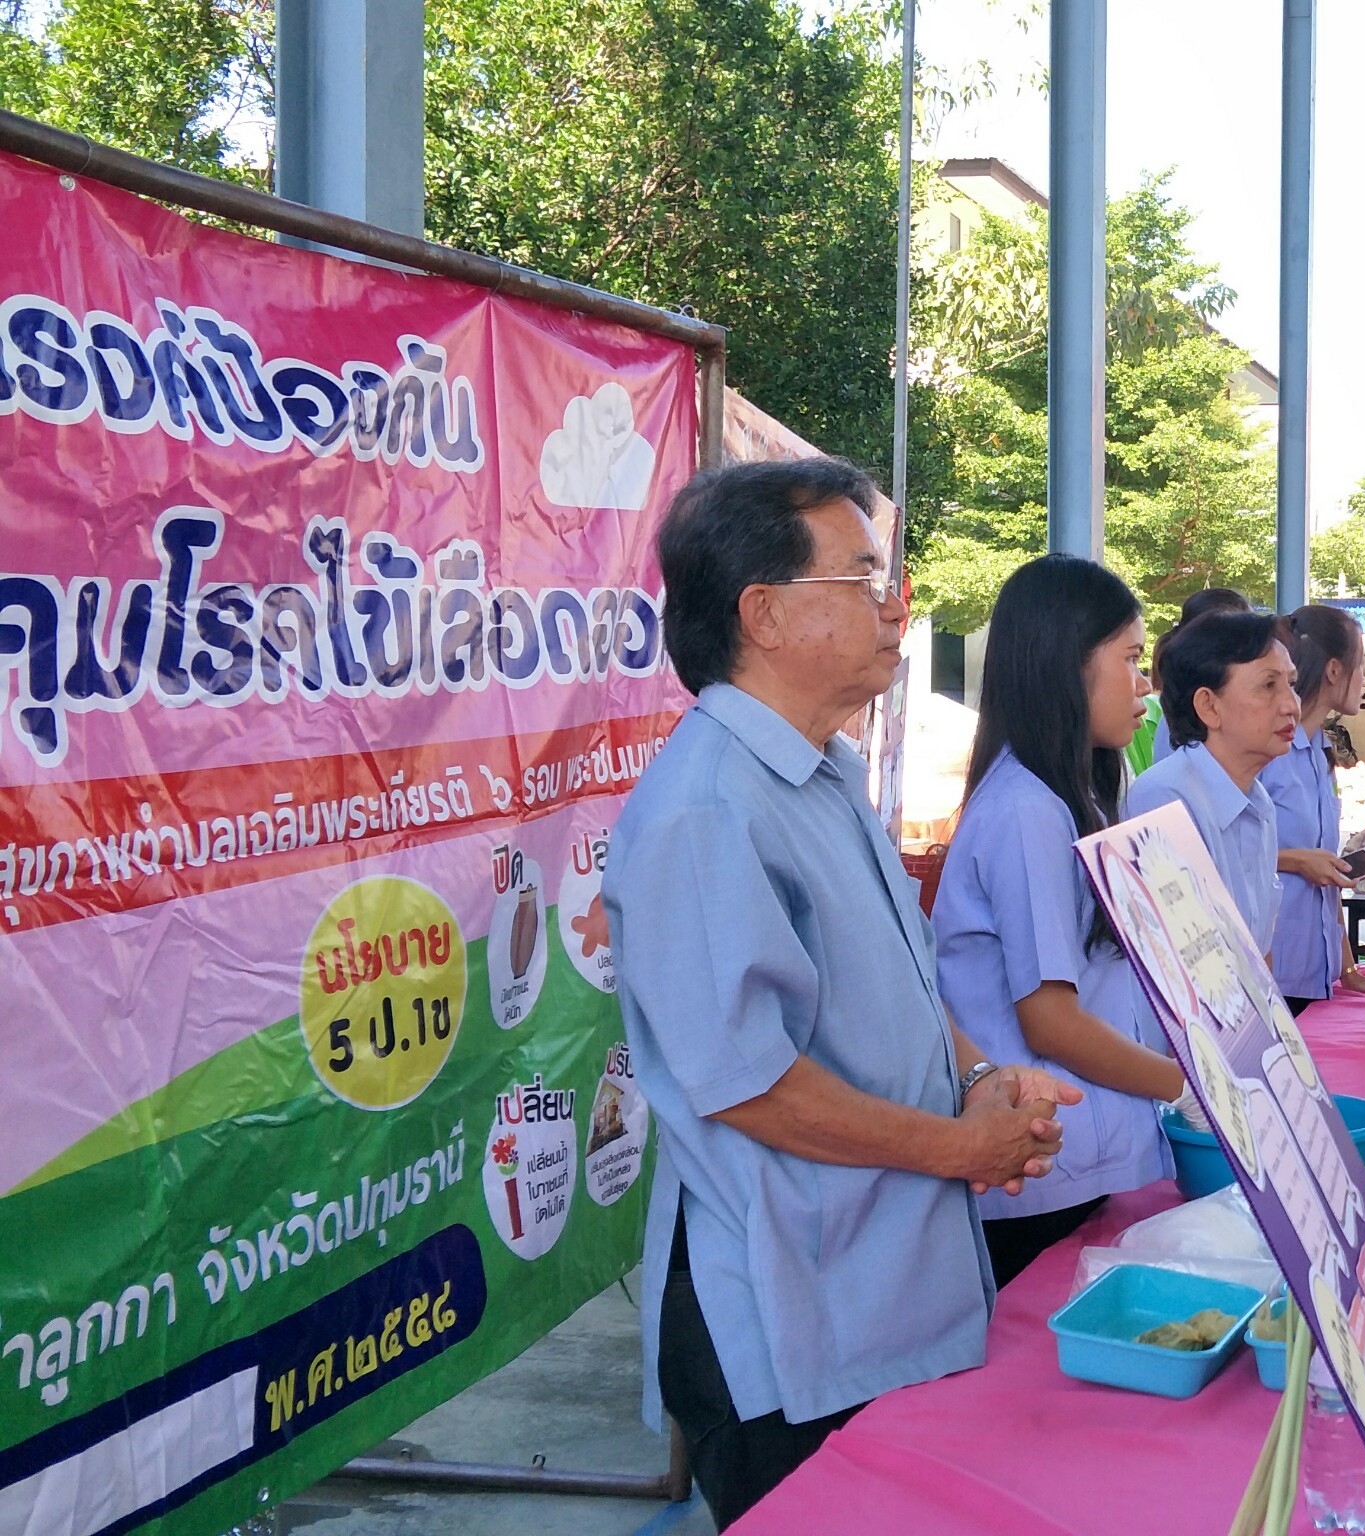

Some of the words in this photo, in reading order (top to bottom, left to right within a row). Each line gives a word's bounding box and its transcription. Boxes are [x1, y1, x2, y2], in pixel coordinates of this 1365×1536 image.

[0, 296, 485, 473] รงค์ป้องกัน
[0, 506, 672, 768] คุมโรคไข้เลือดออ
[523, 762, 562, 806] รอบ
[491, 842, 524, 896] ปิด
[315, 917, 451, 995] นโยบาย
[496, 1074, 576, 1126] เปลี่ยน
